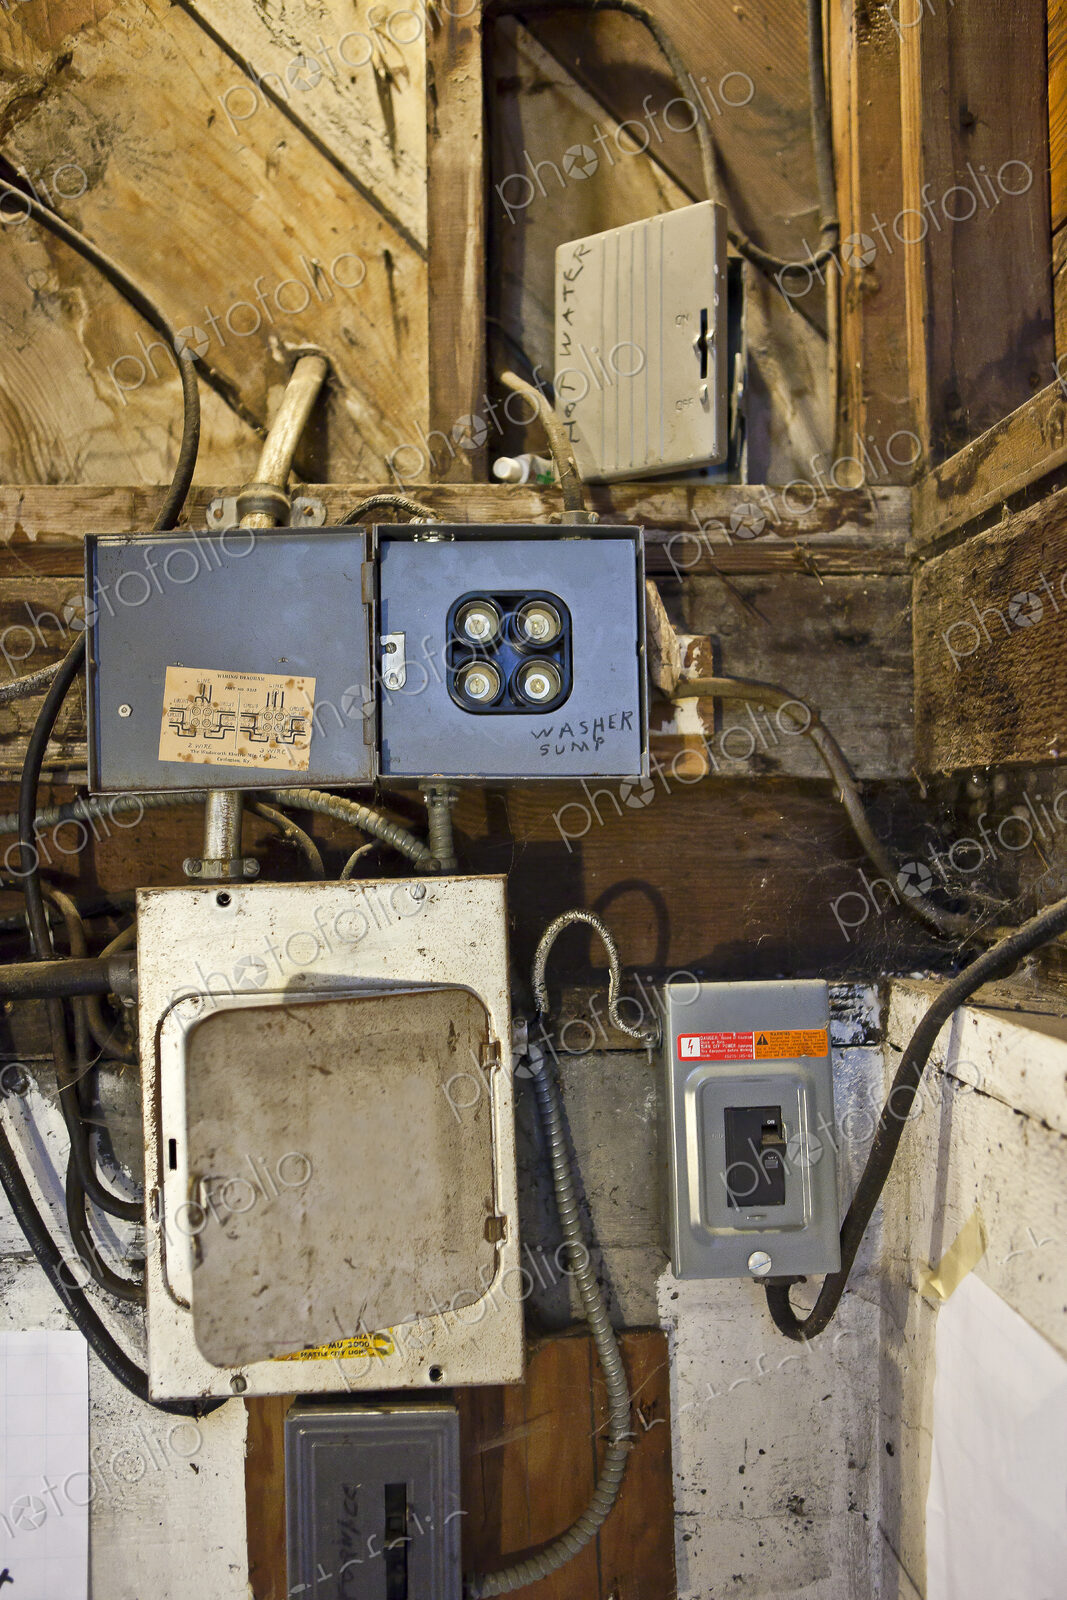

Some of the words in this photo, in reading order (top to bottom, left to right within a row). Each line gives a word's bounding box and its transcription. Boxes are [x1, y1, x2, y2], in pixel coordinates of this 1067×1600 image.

[559, 244, 592, 356] WATER
[560, 376, 579, 443] HOT
[531, 711, 633, 742] WASHER
[539, 737, 605, 756] SUMP
[300, 1350, 327, 1358] SEATTLE
